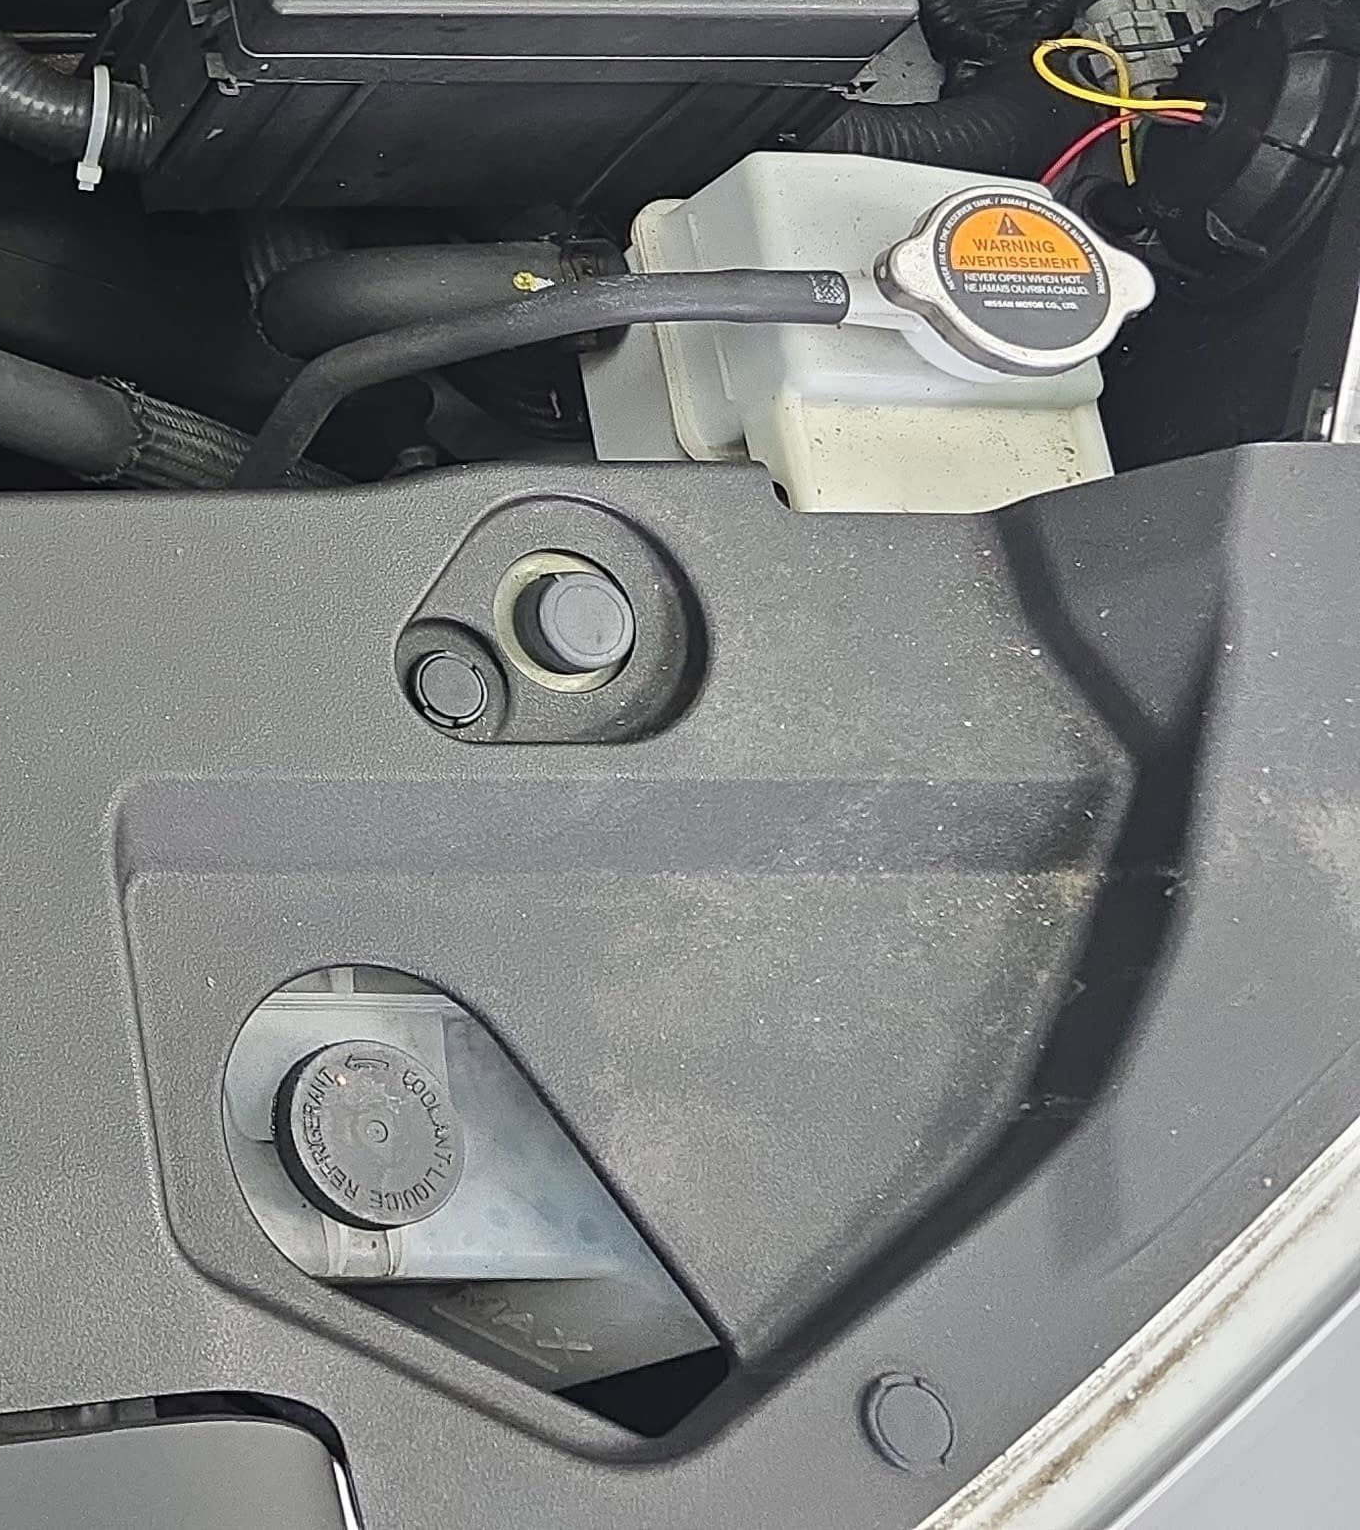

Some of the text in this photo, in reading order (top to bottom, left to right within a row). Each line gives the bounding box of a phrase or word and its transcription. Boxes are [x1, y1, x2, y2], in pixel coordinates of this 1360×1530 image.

[972, 239, 1055, 252] WARNING
[959, 256, 1080, 270] AVERTISSEMENT
[964, 274, 1084, 284] NEVER OPEN WHEN HOT.
